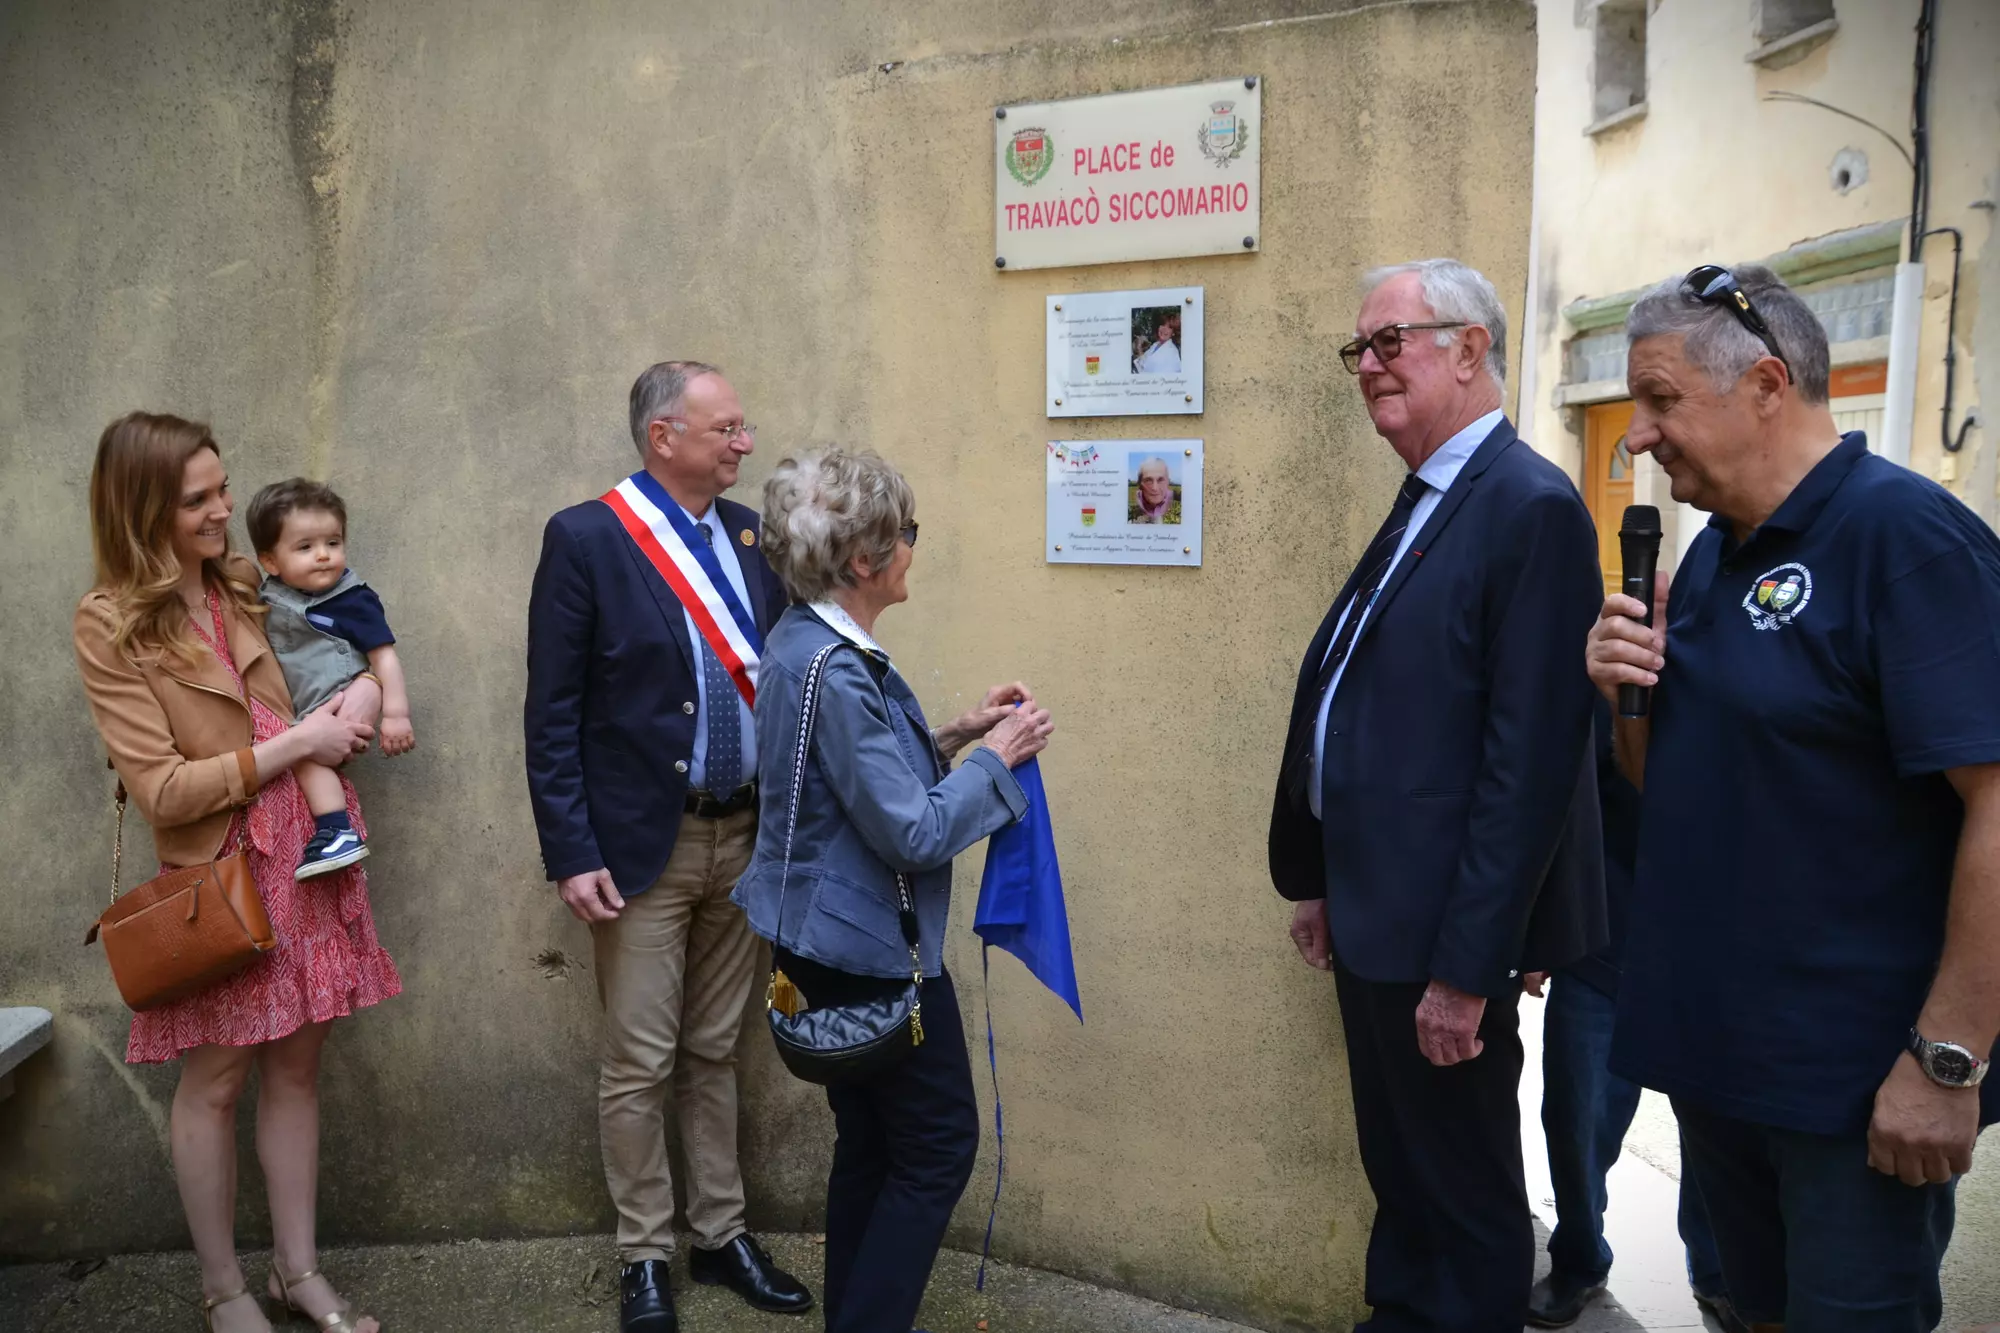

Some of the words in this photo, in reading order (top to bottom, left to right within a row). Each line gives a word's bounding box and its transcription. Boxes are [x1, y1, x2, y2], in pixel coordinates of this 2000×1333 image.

[1074, 142, 1141, 176] PLACE
[1150, 140, 1175, 169] de
[1005, 186, 1100, 231] TRAVACÒ
[1109, 182, 1248, 223] SICCOMARIO
